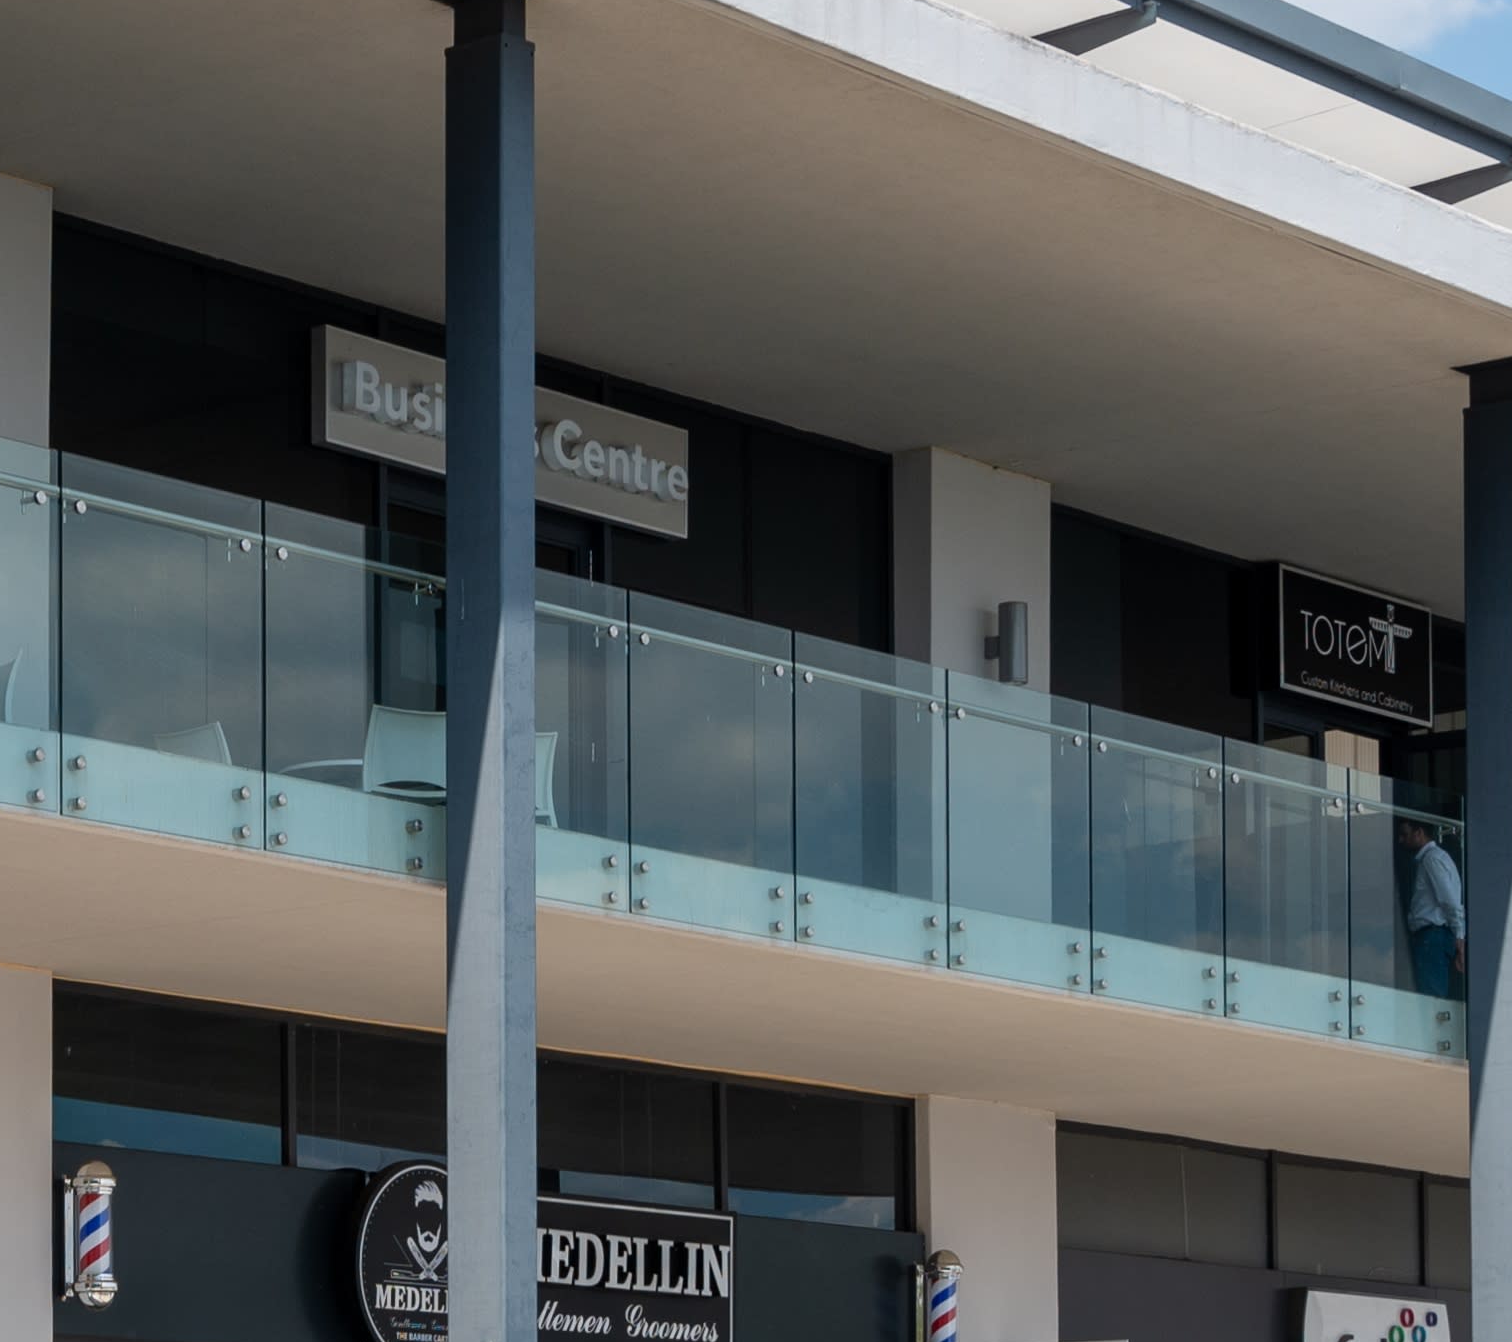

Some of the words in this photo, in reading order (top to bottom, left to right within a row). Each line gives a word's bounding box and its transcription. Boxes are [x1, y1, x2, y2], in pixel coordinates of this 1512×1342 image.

[546, 419, 689, 501] Centre
[1361, 690, 1377, 704] and
[375, 1283, 448, 1314] MEDEL
